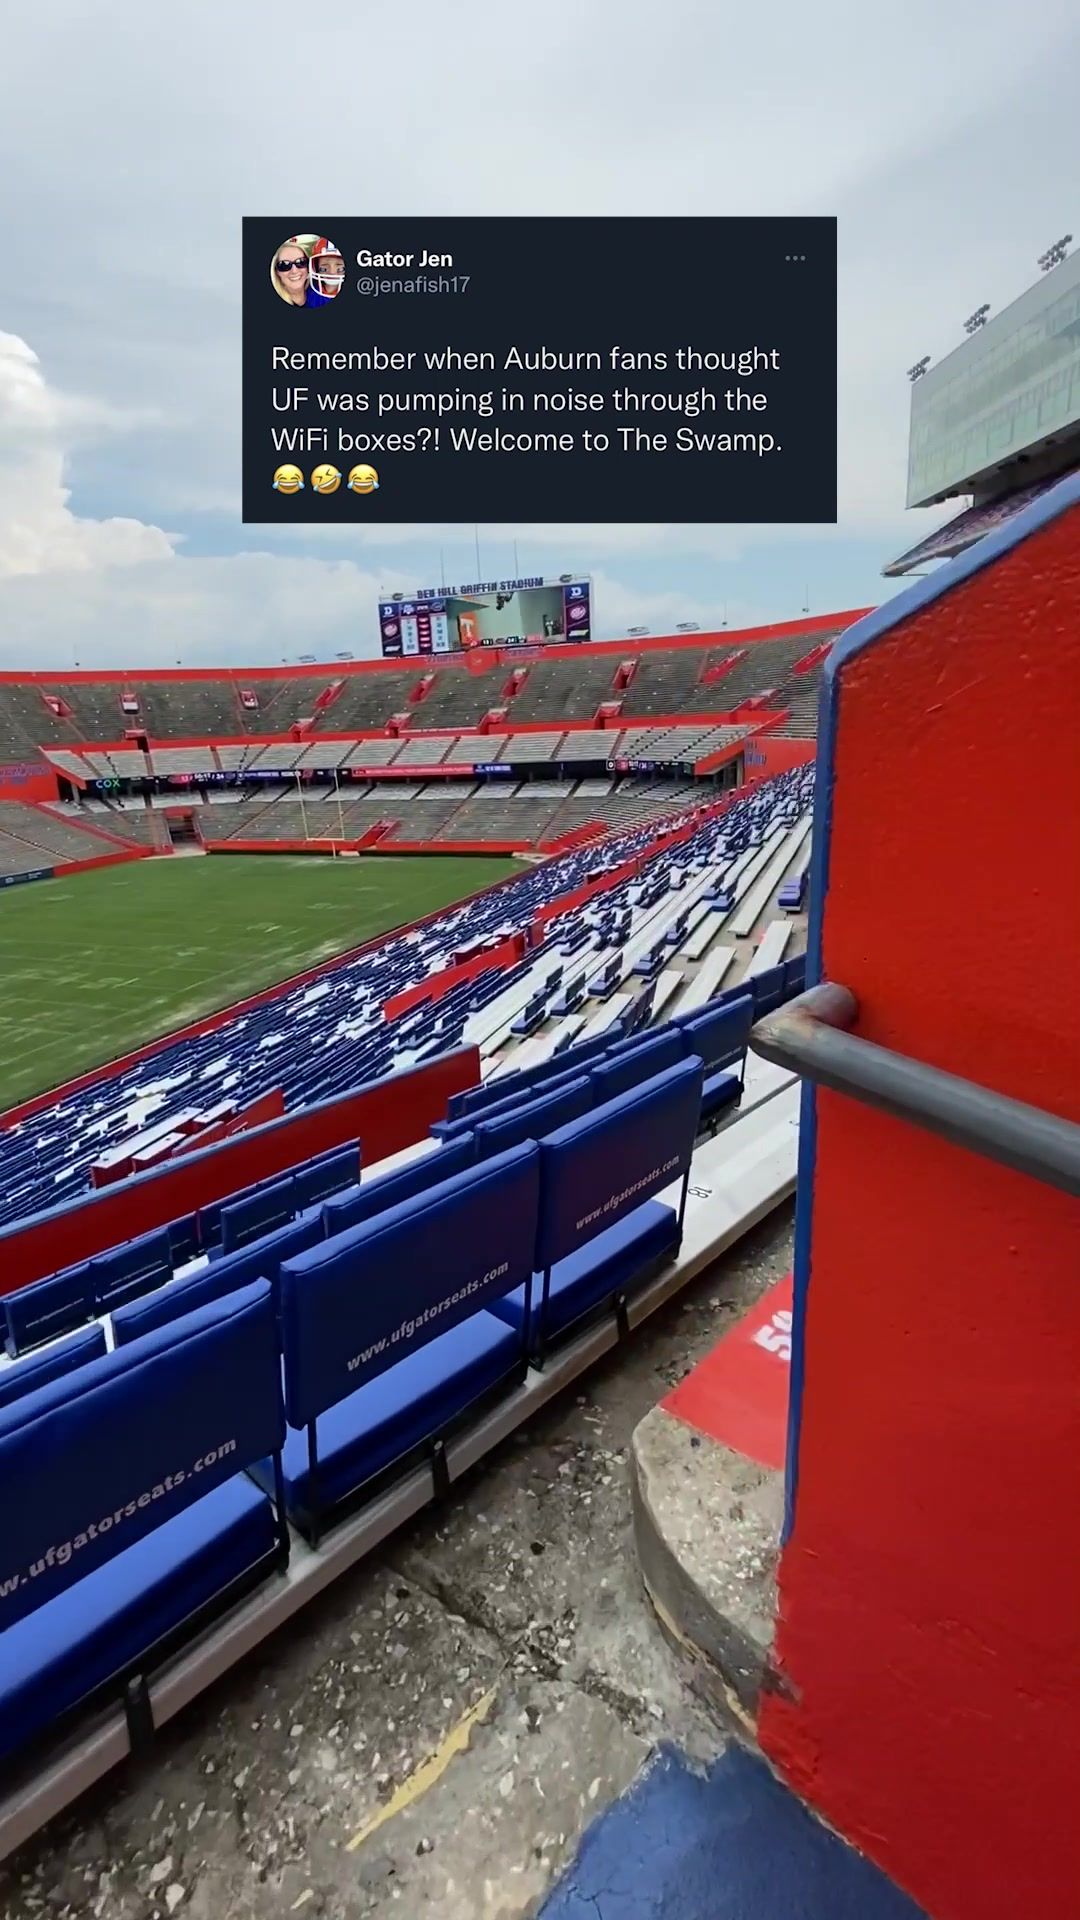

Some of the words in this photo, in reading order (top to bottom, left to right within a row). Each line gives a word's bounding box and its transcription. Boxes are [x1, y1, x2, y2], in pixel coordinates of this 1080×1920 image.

[437, 585, 458, 597] HILL
[460, 581, 498, 595] GRIFFIN
[499, 576, 544, 591] STADIUM
[95, 779, 121, 789] COX
[575, 1154, 681, 1230] www.ufgatorseats.com
[346, 1261, 509, 1372] www.ufgatorseats.com
